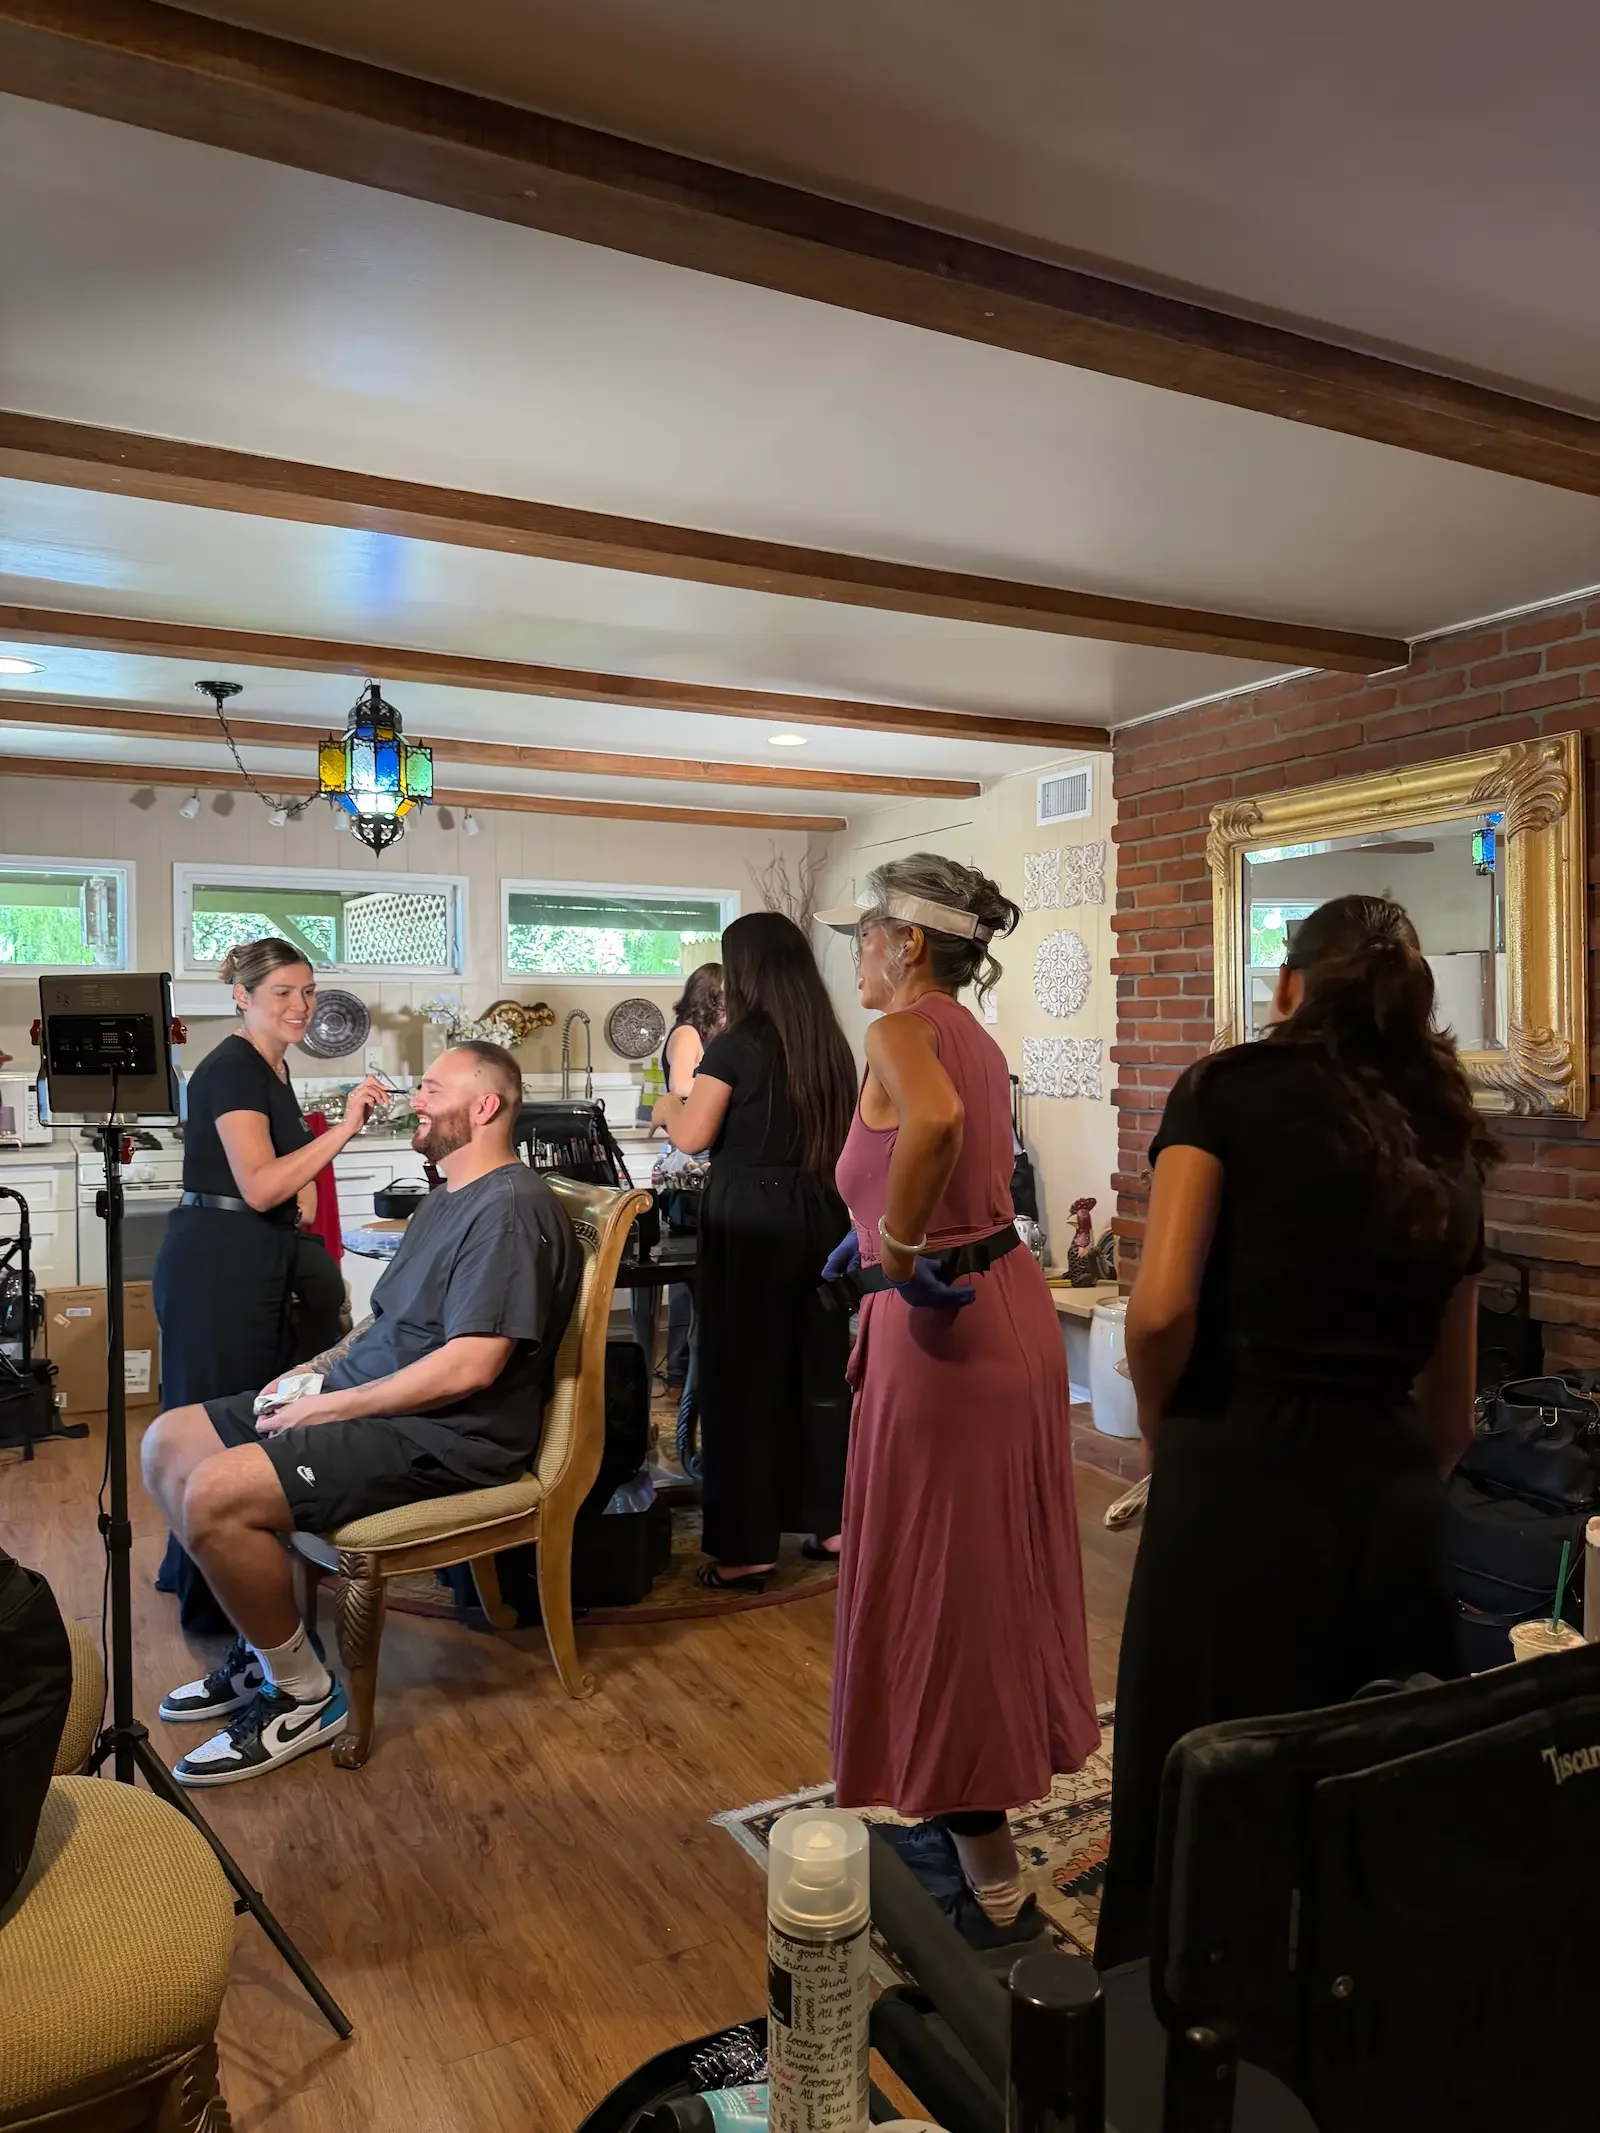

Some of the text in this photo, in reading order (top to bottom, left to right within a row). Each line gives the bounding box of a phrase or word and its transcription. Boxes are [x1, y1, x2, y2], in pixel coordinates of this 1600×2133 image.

[796, 1947, 825, 1961] good
[813, 1964, 834, 1974] on
[817, 2007, 833, 2019] All
[800, 2088, 815, 2100] All
[816, 2085, 845, 2107] good
